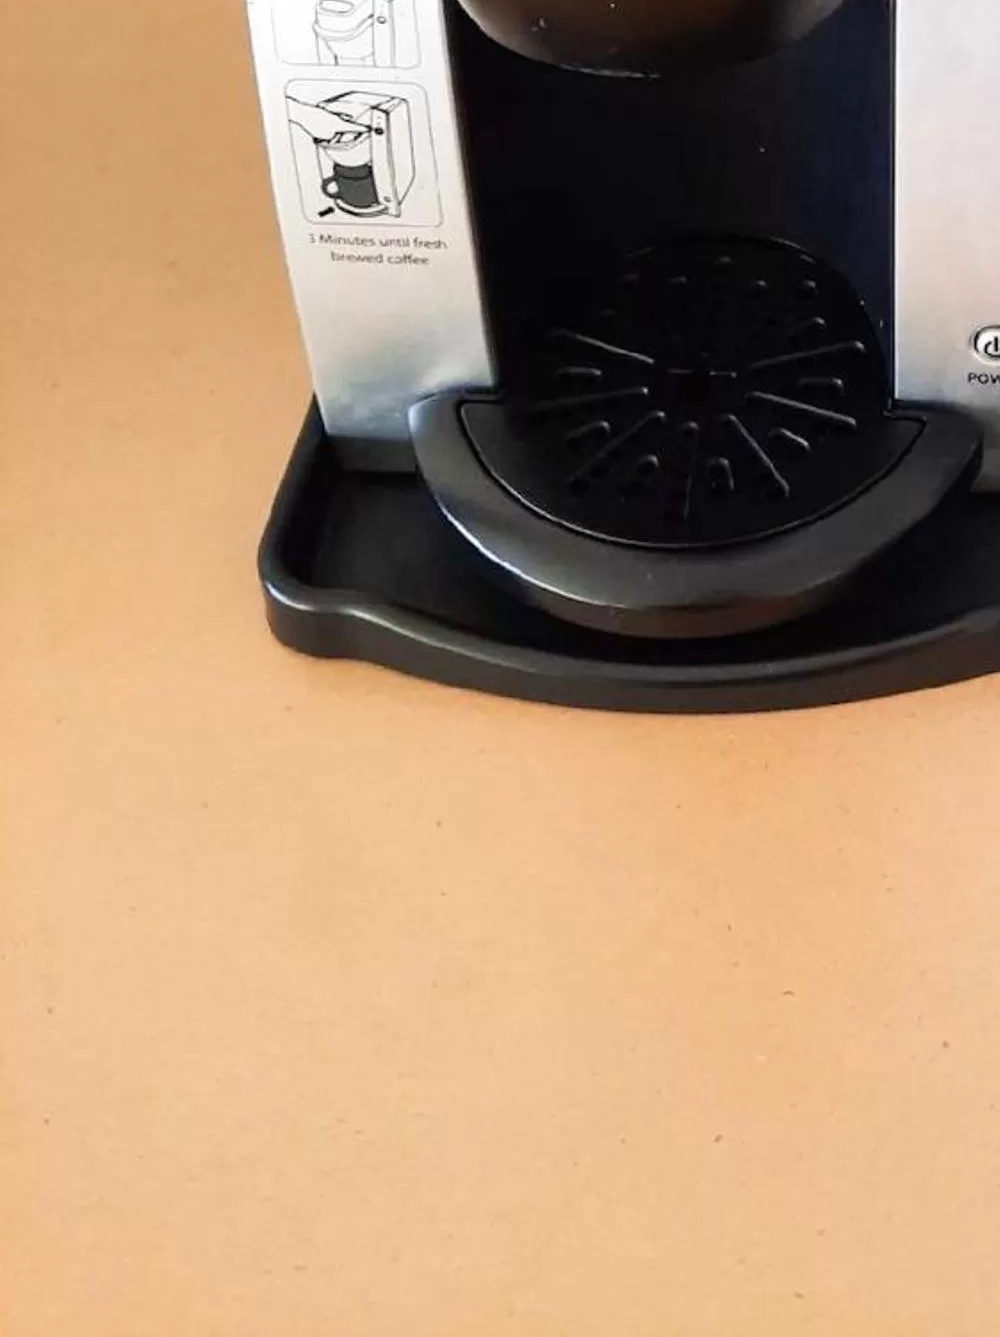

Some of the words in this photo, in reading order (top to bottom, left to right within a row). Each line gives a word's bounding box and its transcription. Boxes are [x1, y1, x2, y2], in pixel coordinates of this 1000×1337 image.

[318, 233, 376, 248] Minutes
[379, 236, 411, 248] until
[412, 237, 449, 250] fresh
[330, 250, 384, 264] brewed
[387, 253, 430, 265] coffee
